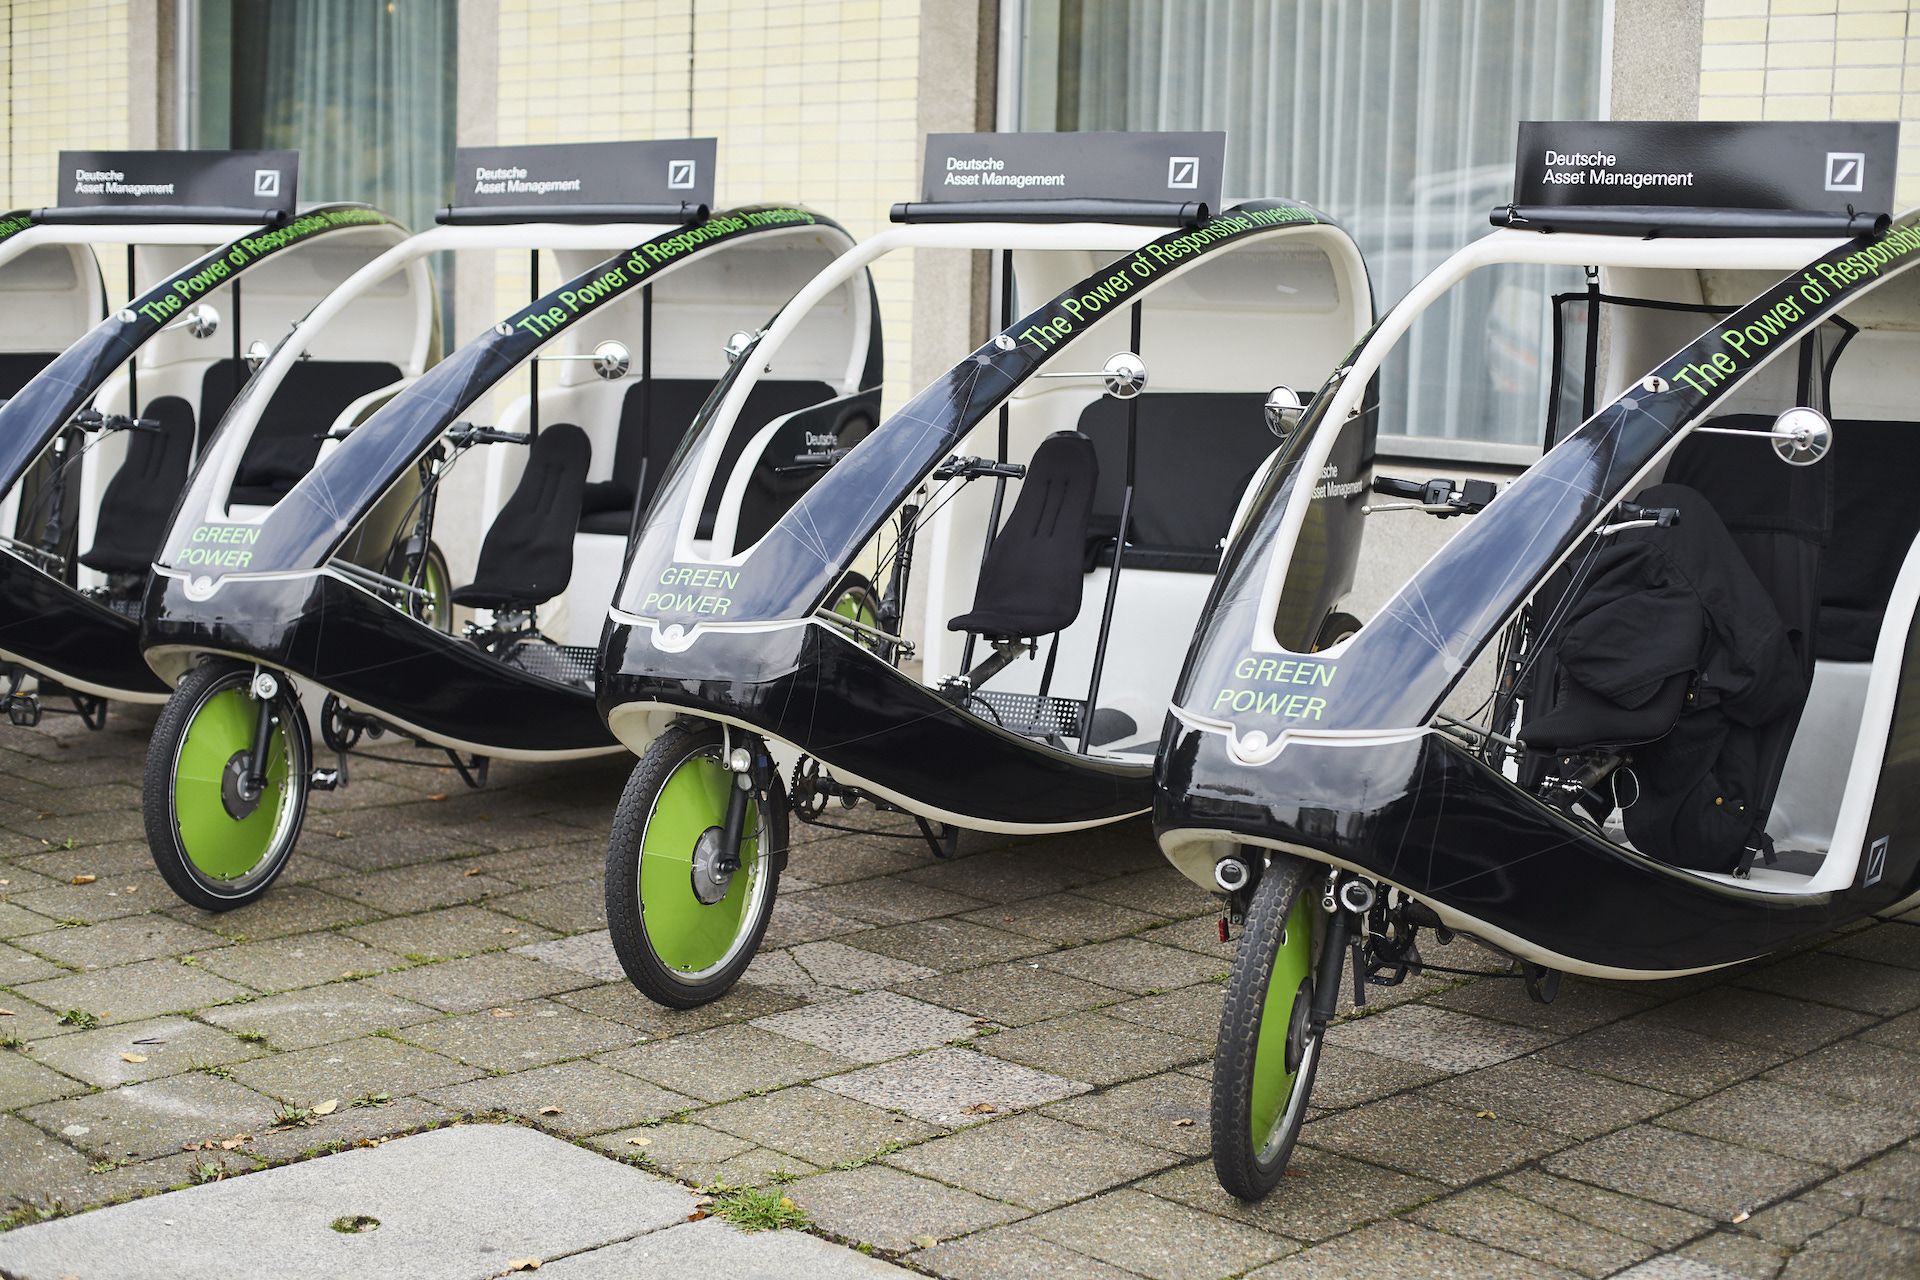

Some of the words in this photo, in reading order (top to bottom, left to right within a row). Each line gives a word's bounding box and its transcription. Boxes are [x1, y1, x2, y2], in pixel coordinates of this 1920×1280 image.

[946, 157, 1004, 170] Deutsche
[1544, 151, 1616, 167] Deutsche
[76, 170, 123, 181] Deutsche
[477, 167, 527, 181] Deutsche
[944, 172, 979, 186] Asset
[982, 172, 1065, 188] Management
[1542, 169, 1586, 184] Asset
[1590, 169, 1694, 189] Management
[75, 183, 103, 195] Asset
[105, 183, 174, 196] Management
[475, 180, 505, 194] Asset
[508, 179, 580, 194] Management
[138, 294, 183, 324] The
[172, 256, 231, 300] Power
[227, 244, 249, 266] of
[240, 214, 330, 256] Responsible
[516, 306, 568, 338] The
[557, 267, 629, 313] Power
[626, 250, 652, 275] of
[641, 214, 748, 264] Responsible
[738, 207, 816, 226] Investing
[1019, 314, 1072, 353] The
[1060, 269, 1135, 321] Power
[1130, 252, 1158, 277] of
[1145, 209, 1252, 265] Responsible
[1240, 203, 1319, 226] Investing
[1672, 351, 1738, 397] The
[1720, 295, 1806, 360] Power
[1800, 272, 1831, 305] of
[1311, 485, 1327, 500] sset
[1327, 480, 1363, 499] Management
[192, 526, 261, 545] GREEN
[176, 548, 253, 568] POWER
[660, 567, 740, 589] GREEN
[642, 592, 732, 615] POWER
[1234, 657, 1338, 687] GREEN
[1212, 689, 1327, 720] POWER
